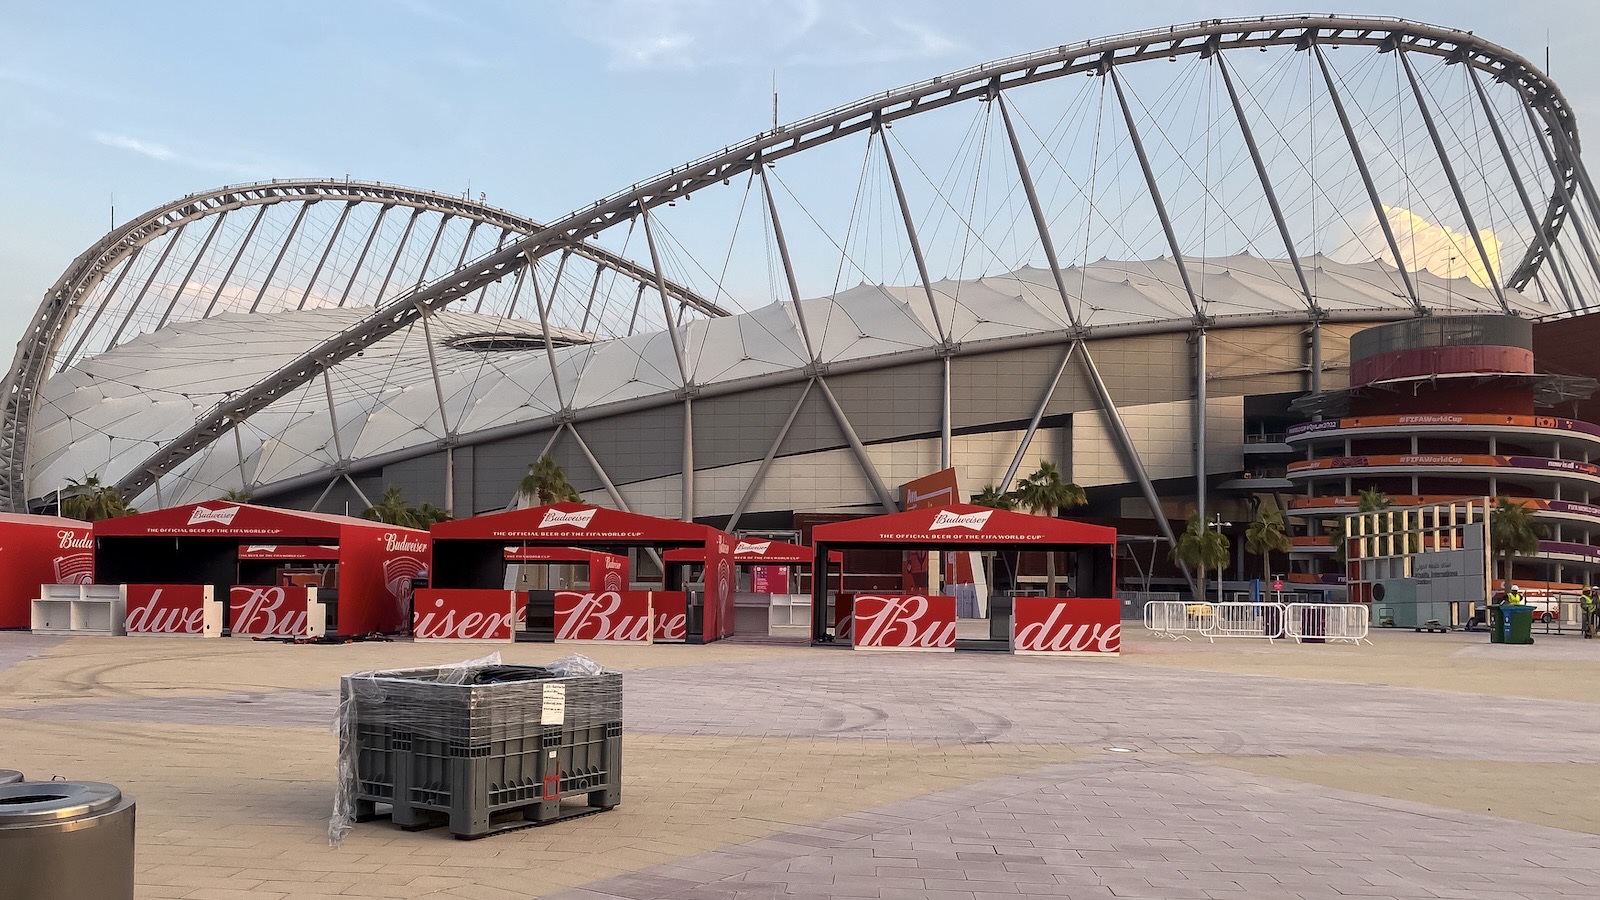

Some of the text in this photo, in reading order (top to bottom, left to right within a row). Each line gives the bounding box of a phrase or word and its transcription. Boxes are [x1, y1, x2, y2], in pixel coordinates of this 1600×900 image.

[1399, 416, 1463, 424] #FIFAWorldCup
[1399, 456, 1463, 464] #FIFAWorldCup
[191, 510, 234, 520] Budweiser
[543, 512, 591, 522] Budweiser
[934, 513, 986, 524] Budweiser
[384, 533, 428, 552] Budweiser
[739, 543, 767, 551] Budweiser
[230, 586, 307, 635] Bu
[555, 591, 651, 640] Bu
[414, 598, 511, 639] iser
[855, 596, 956, 647] Bu
